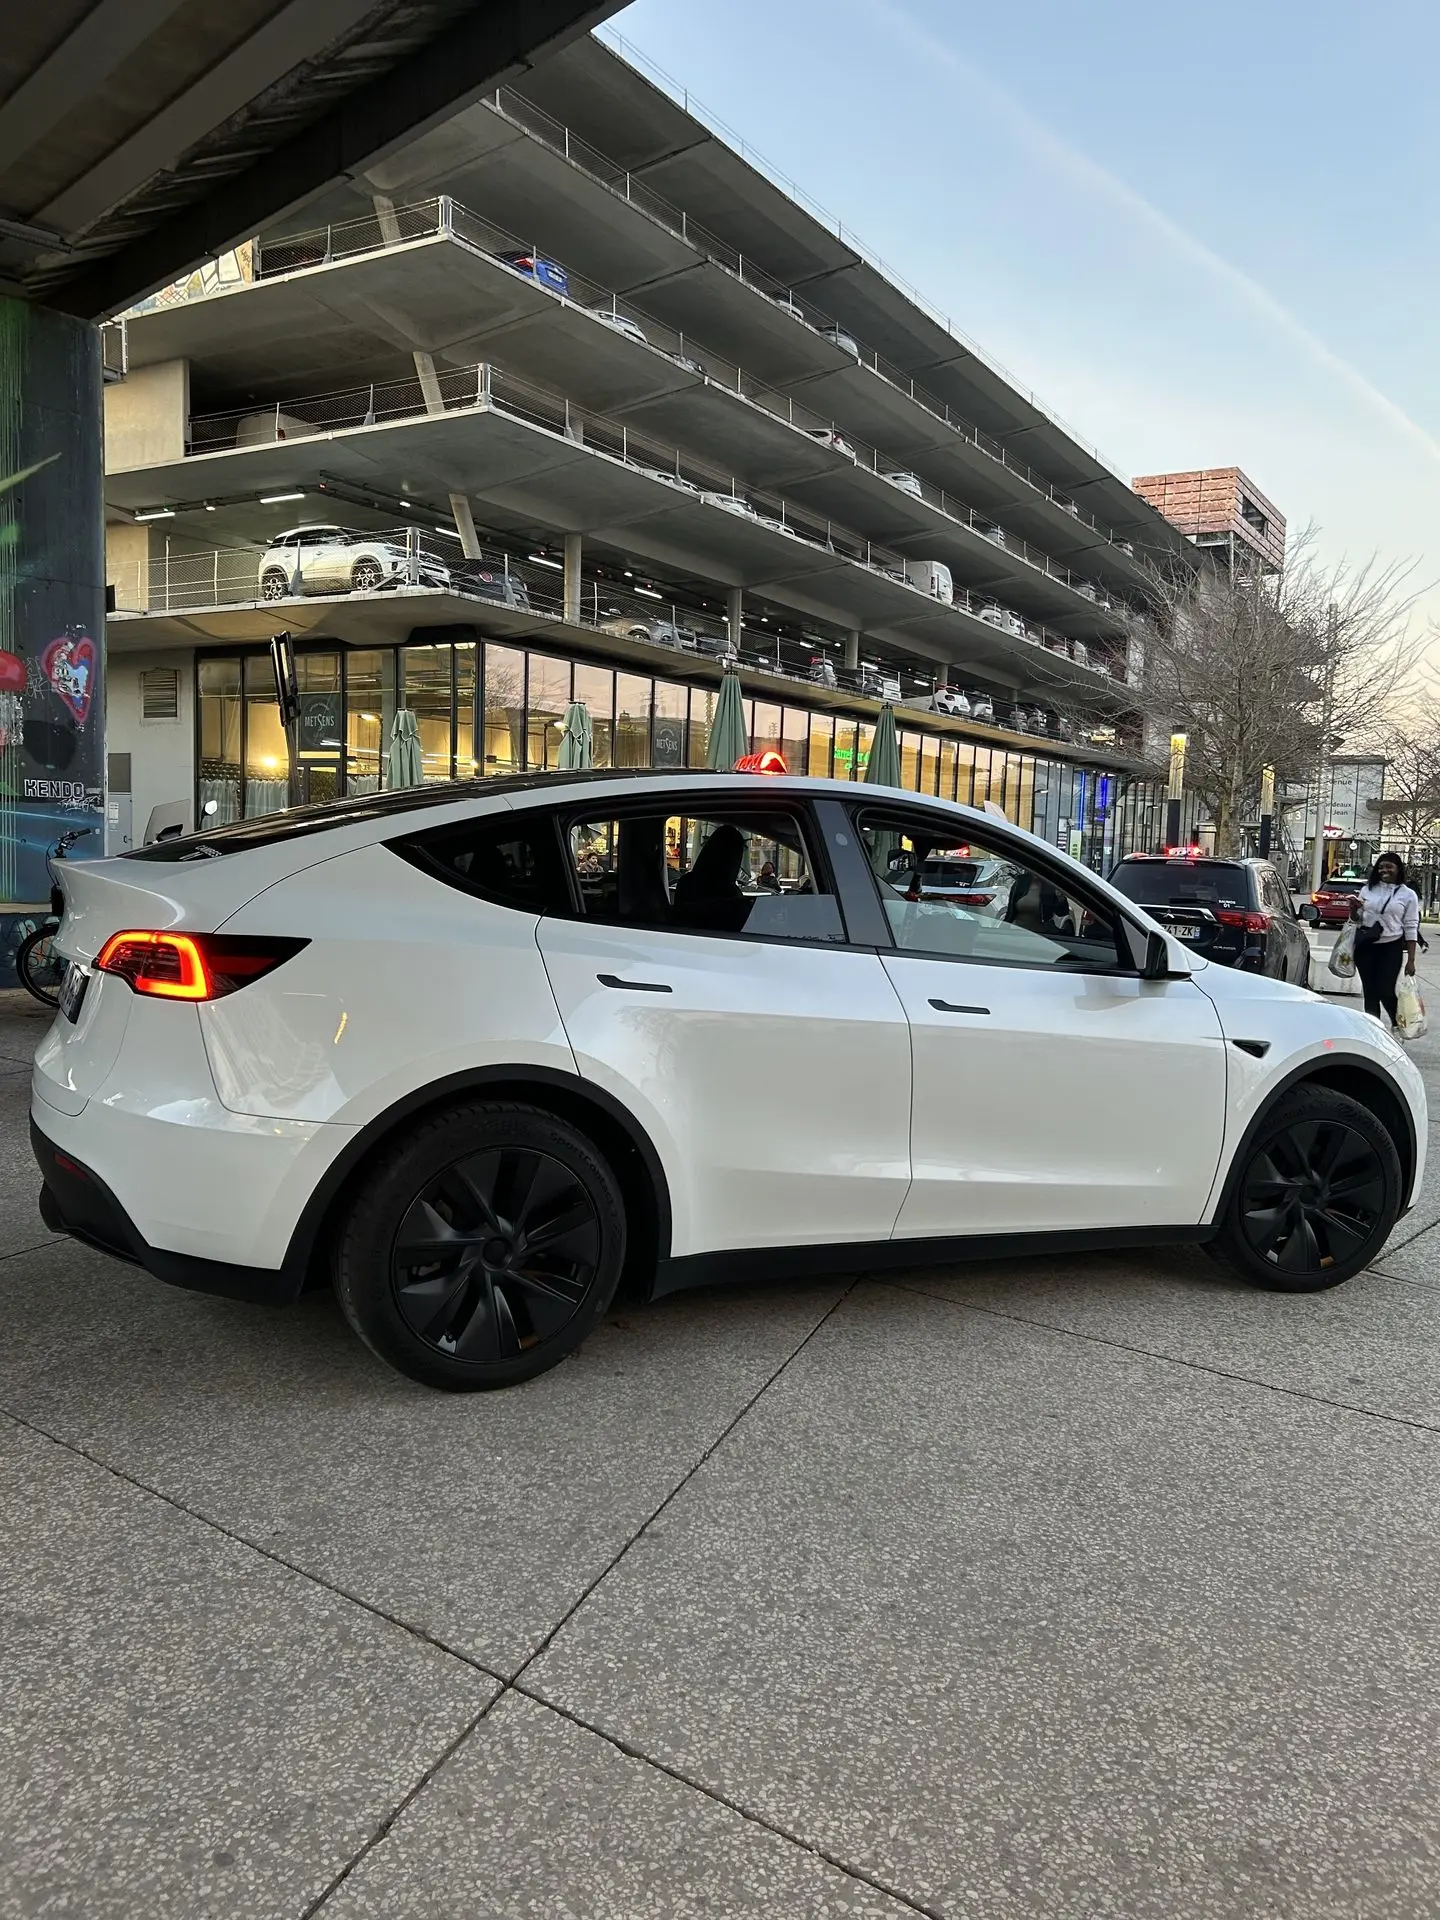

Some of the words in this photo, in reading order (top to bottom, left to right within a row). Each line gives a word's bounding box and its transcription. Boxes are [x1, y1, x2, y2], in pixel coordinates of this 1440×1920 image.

[304, 714, 335, 731] METSENS
[24, 779, 84, 799] KENDO
[1323, 829, 1344, 838] NCF
